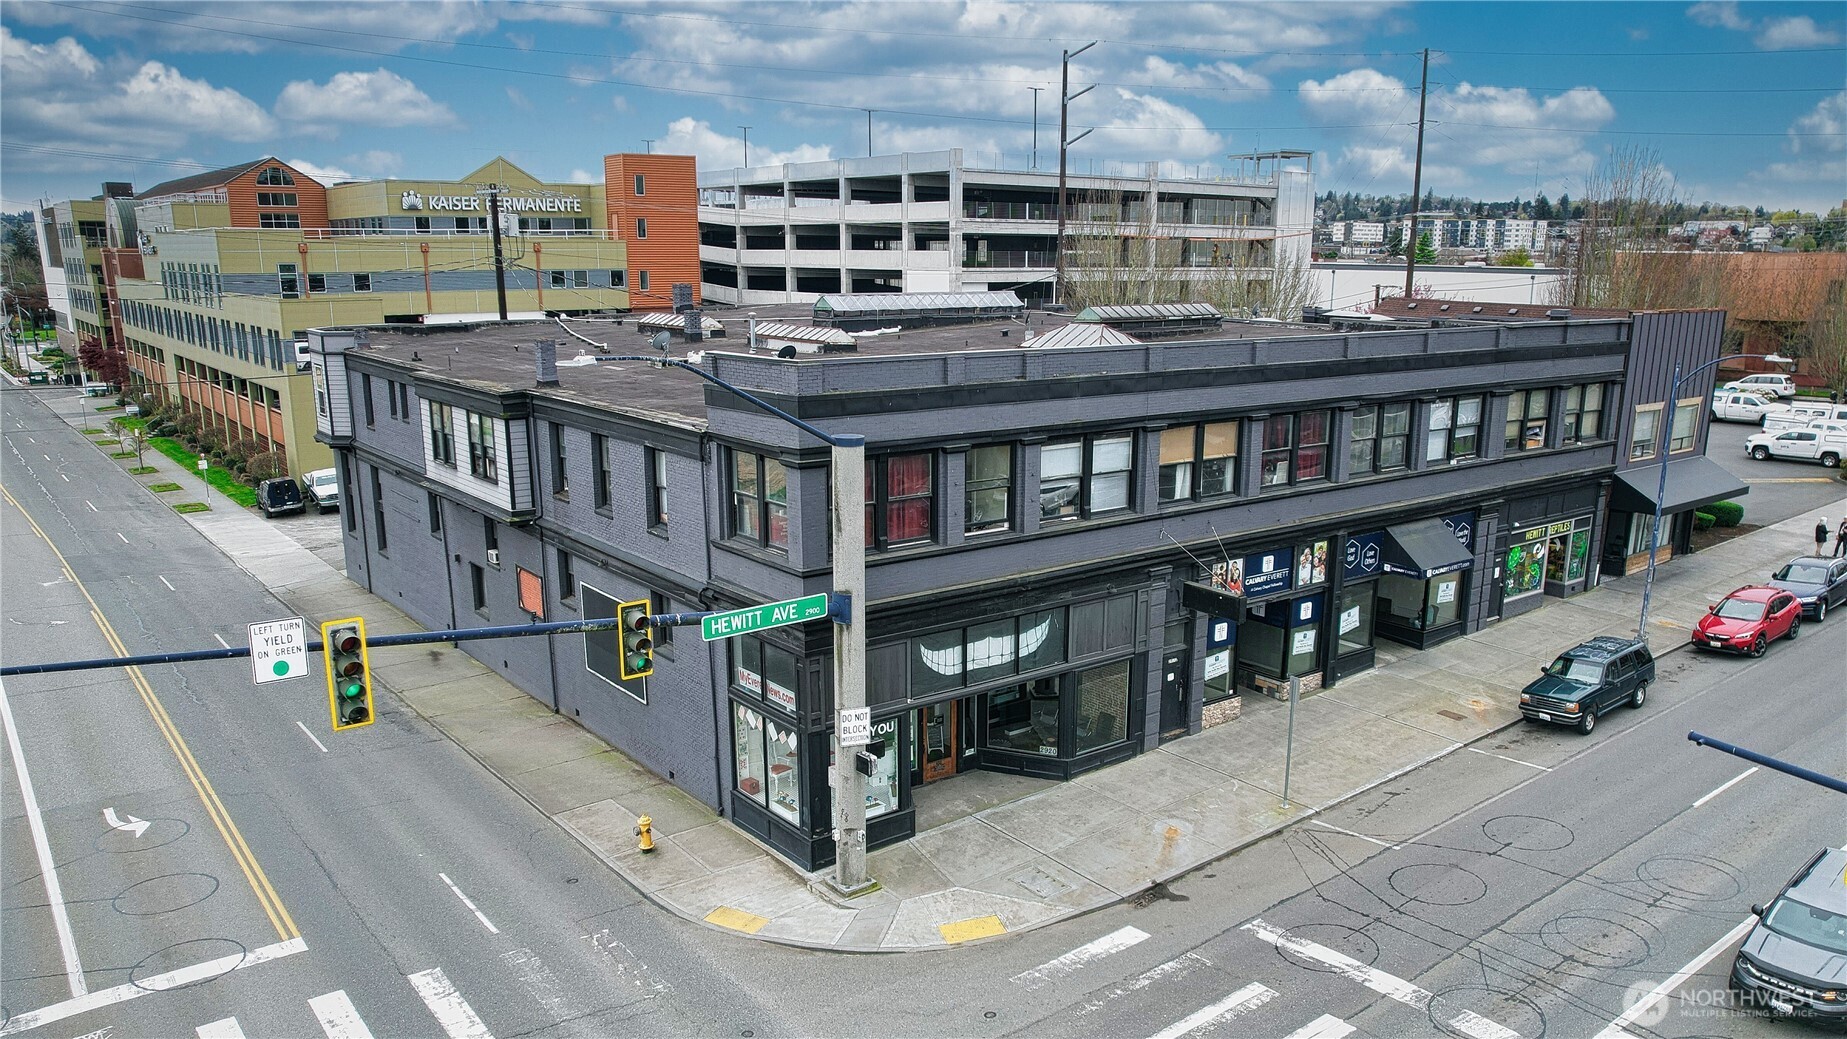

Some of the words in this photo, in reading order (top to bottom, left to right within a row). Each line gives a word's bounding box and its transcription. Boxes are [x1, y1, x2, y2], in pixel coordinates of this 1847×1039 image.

[428, 195, 480, 211] KAISER
[1525, 527, 1546, 540] HEWITT
[711, 610, 762, 634] HEWITT
[771, 604, 798, 622] AVE
[804, 606, 820, 616] 2900
[253, 626, 272, 636] LEFT
[279, 622, 300, 632] TURN
[264, 634, 293, 646] YIELD
[258, 650, 269, 660] ON
[275, 646, 302, 656] GREEN
[842, 714, 852, 723] DO
[854, 712, 868, 721] NOT
[843, 724, 868, 735] BLOCK
[870, 720, 894, 736] YOU
